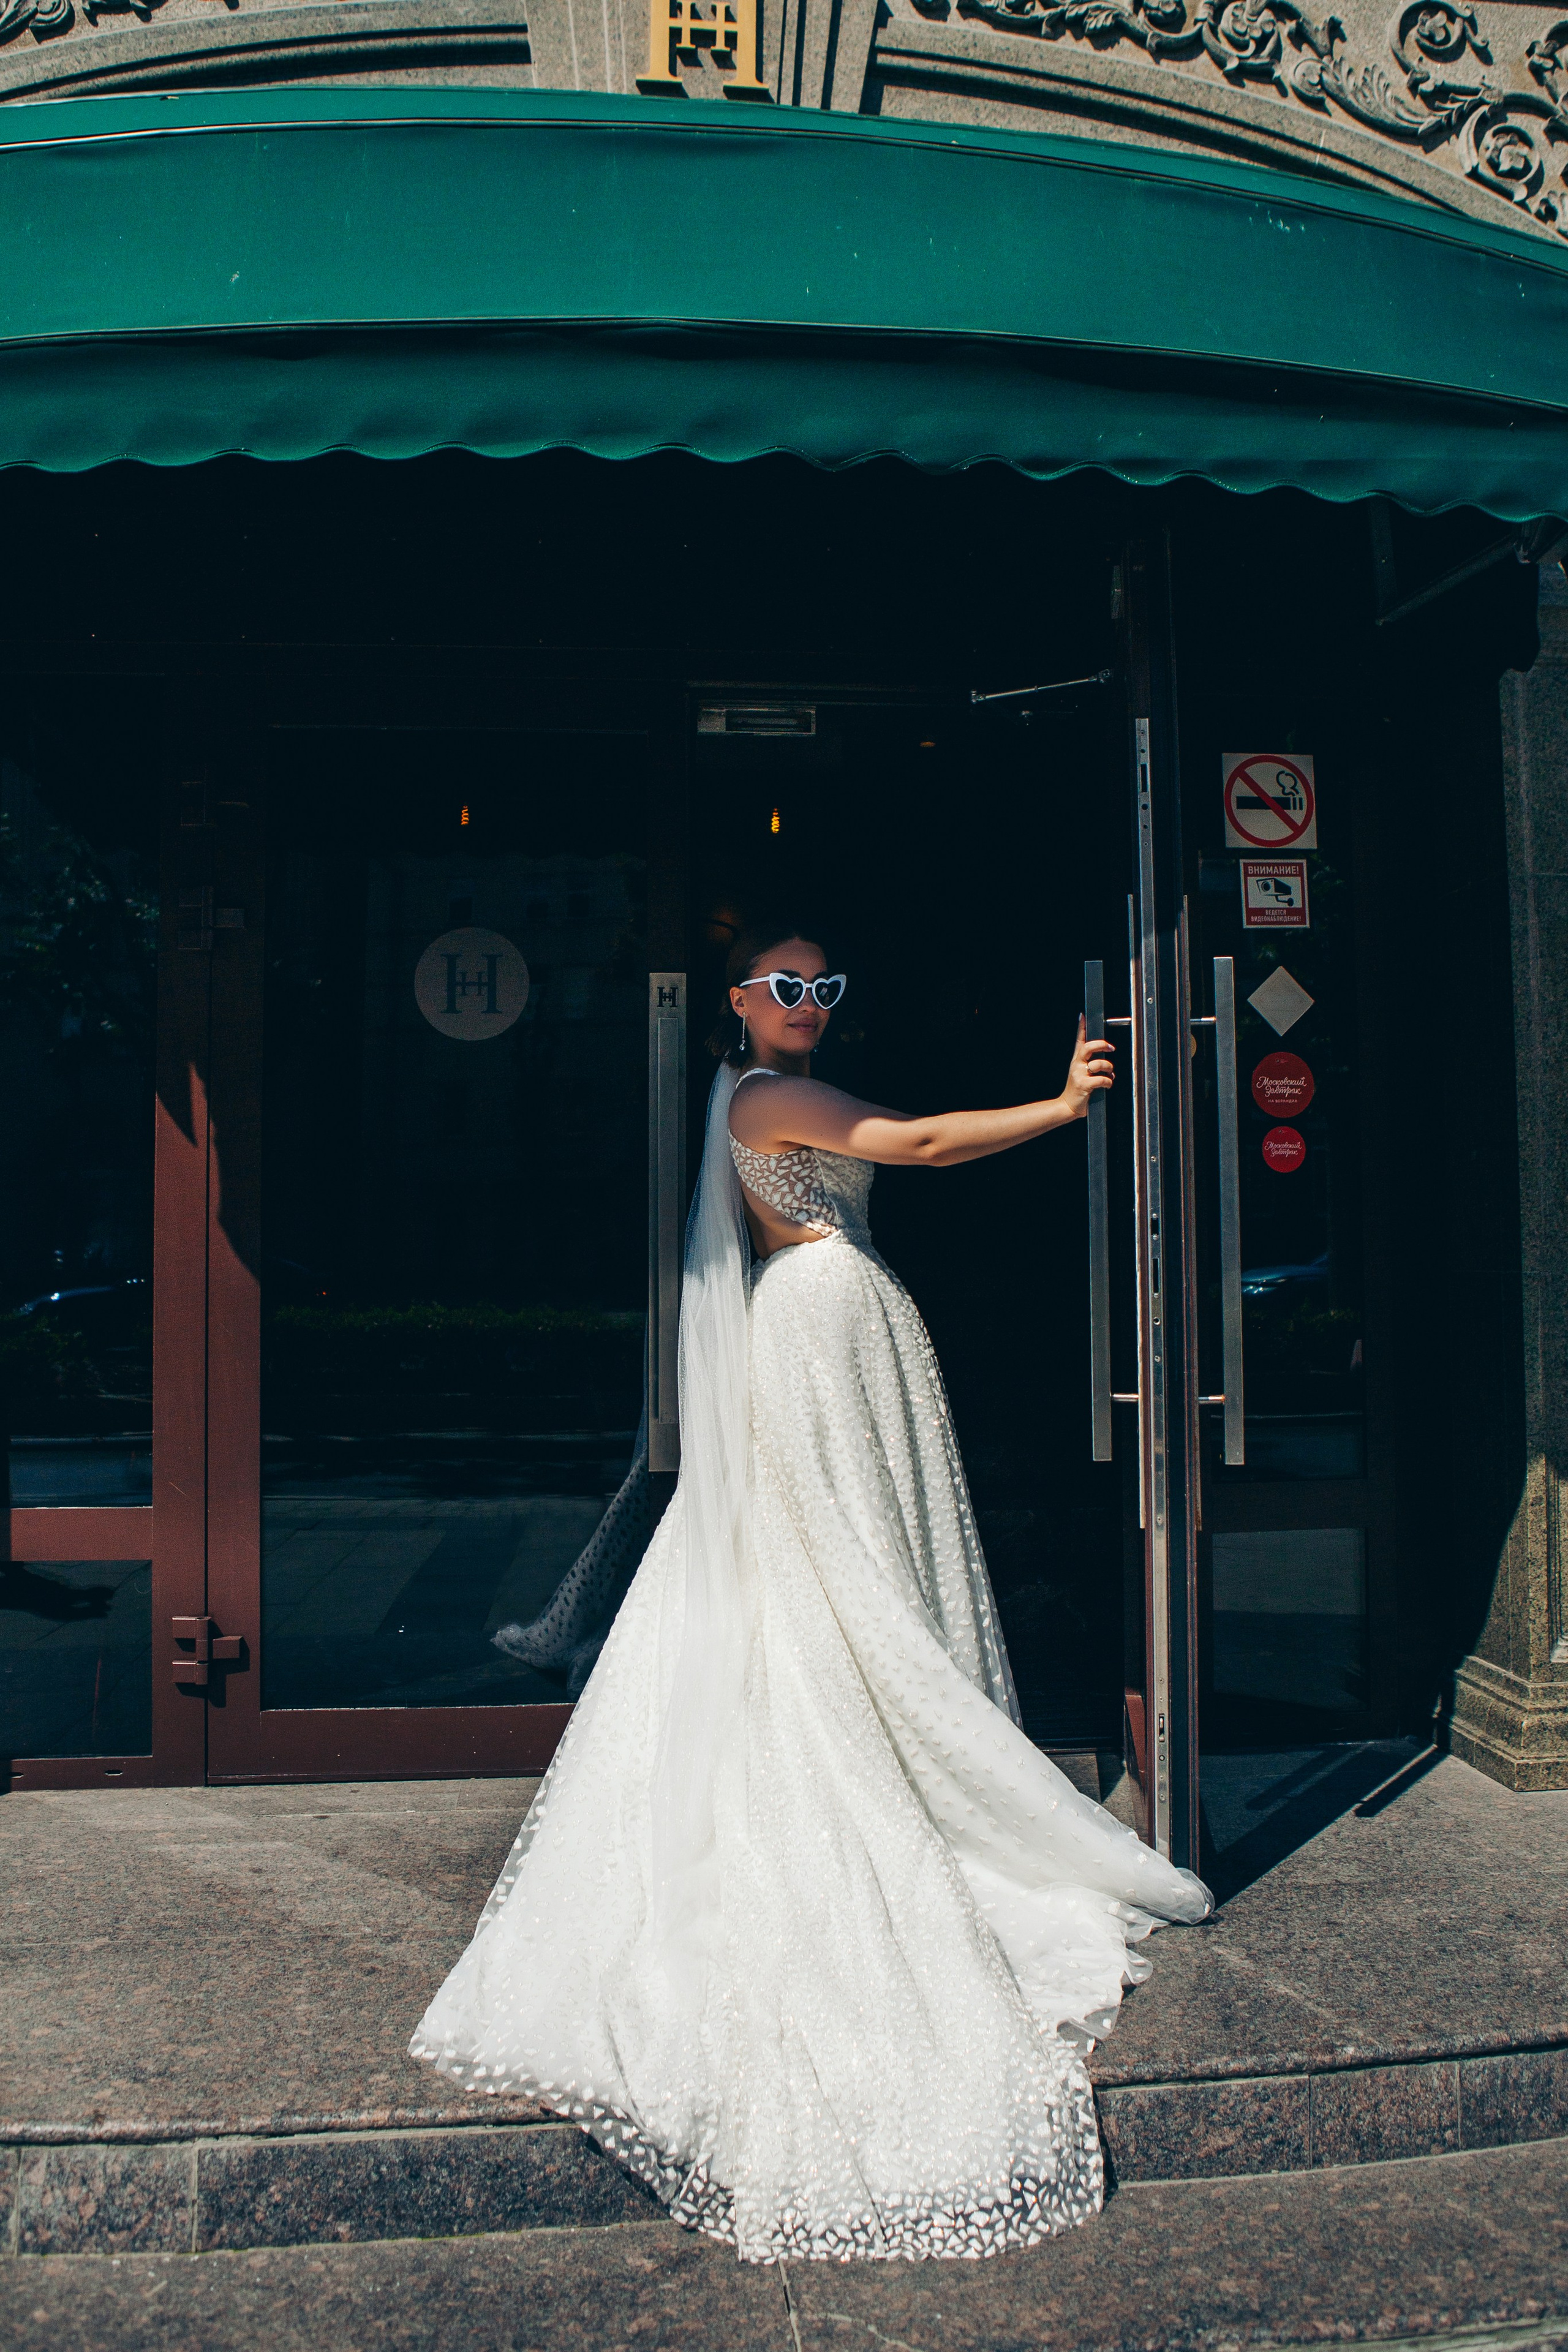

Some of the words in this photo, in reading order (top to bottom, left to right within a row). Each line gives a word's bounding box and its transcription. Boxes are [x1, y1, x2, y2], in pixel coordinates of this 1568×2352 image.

[1248, 865, 1299, 875] ВНИМАНИЕ!
[1256, 1076, 1307, 1088] Московский
[1264, 1085, 1302, 1098] Завтрак
